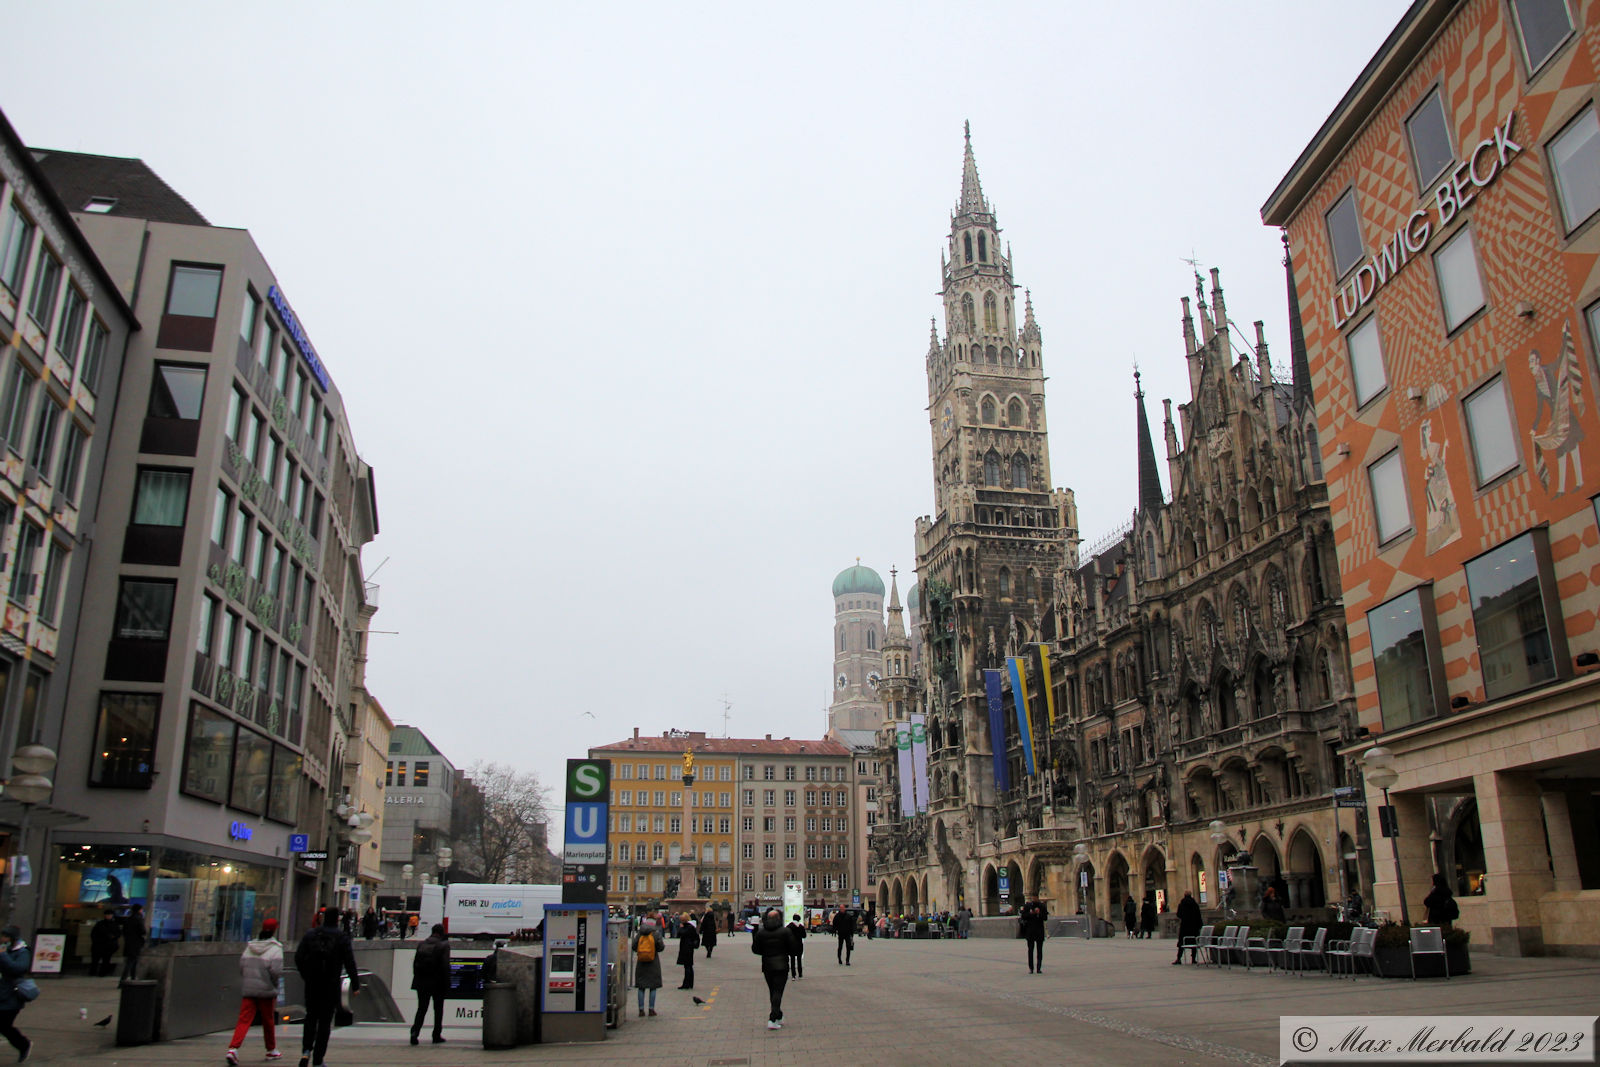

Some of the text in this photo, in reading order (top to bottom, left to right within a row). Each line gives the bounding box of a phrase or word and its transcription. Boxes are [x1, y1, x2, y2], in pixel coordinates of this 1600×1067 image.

[1331, 110, 1523, 330] LUDWIG BECK
[575, 764, 601, 796] S
[384, 796, 425, 804] ALERIA
[574, 807, 598, 838] U
[565, 851, 606, 860] Marienplatz
[458, 899, 477, 908] MEHR
[480, 899, 490, 908] ZU
